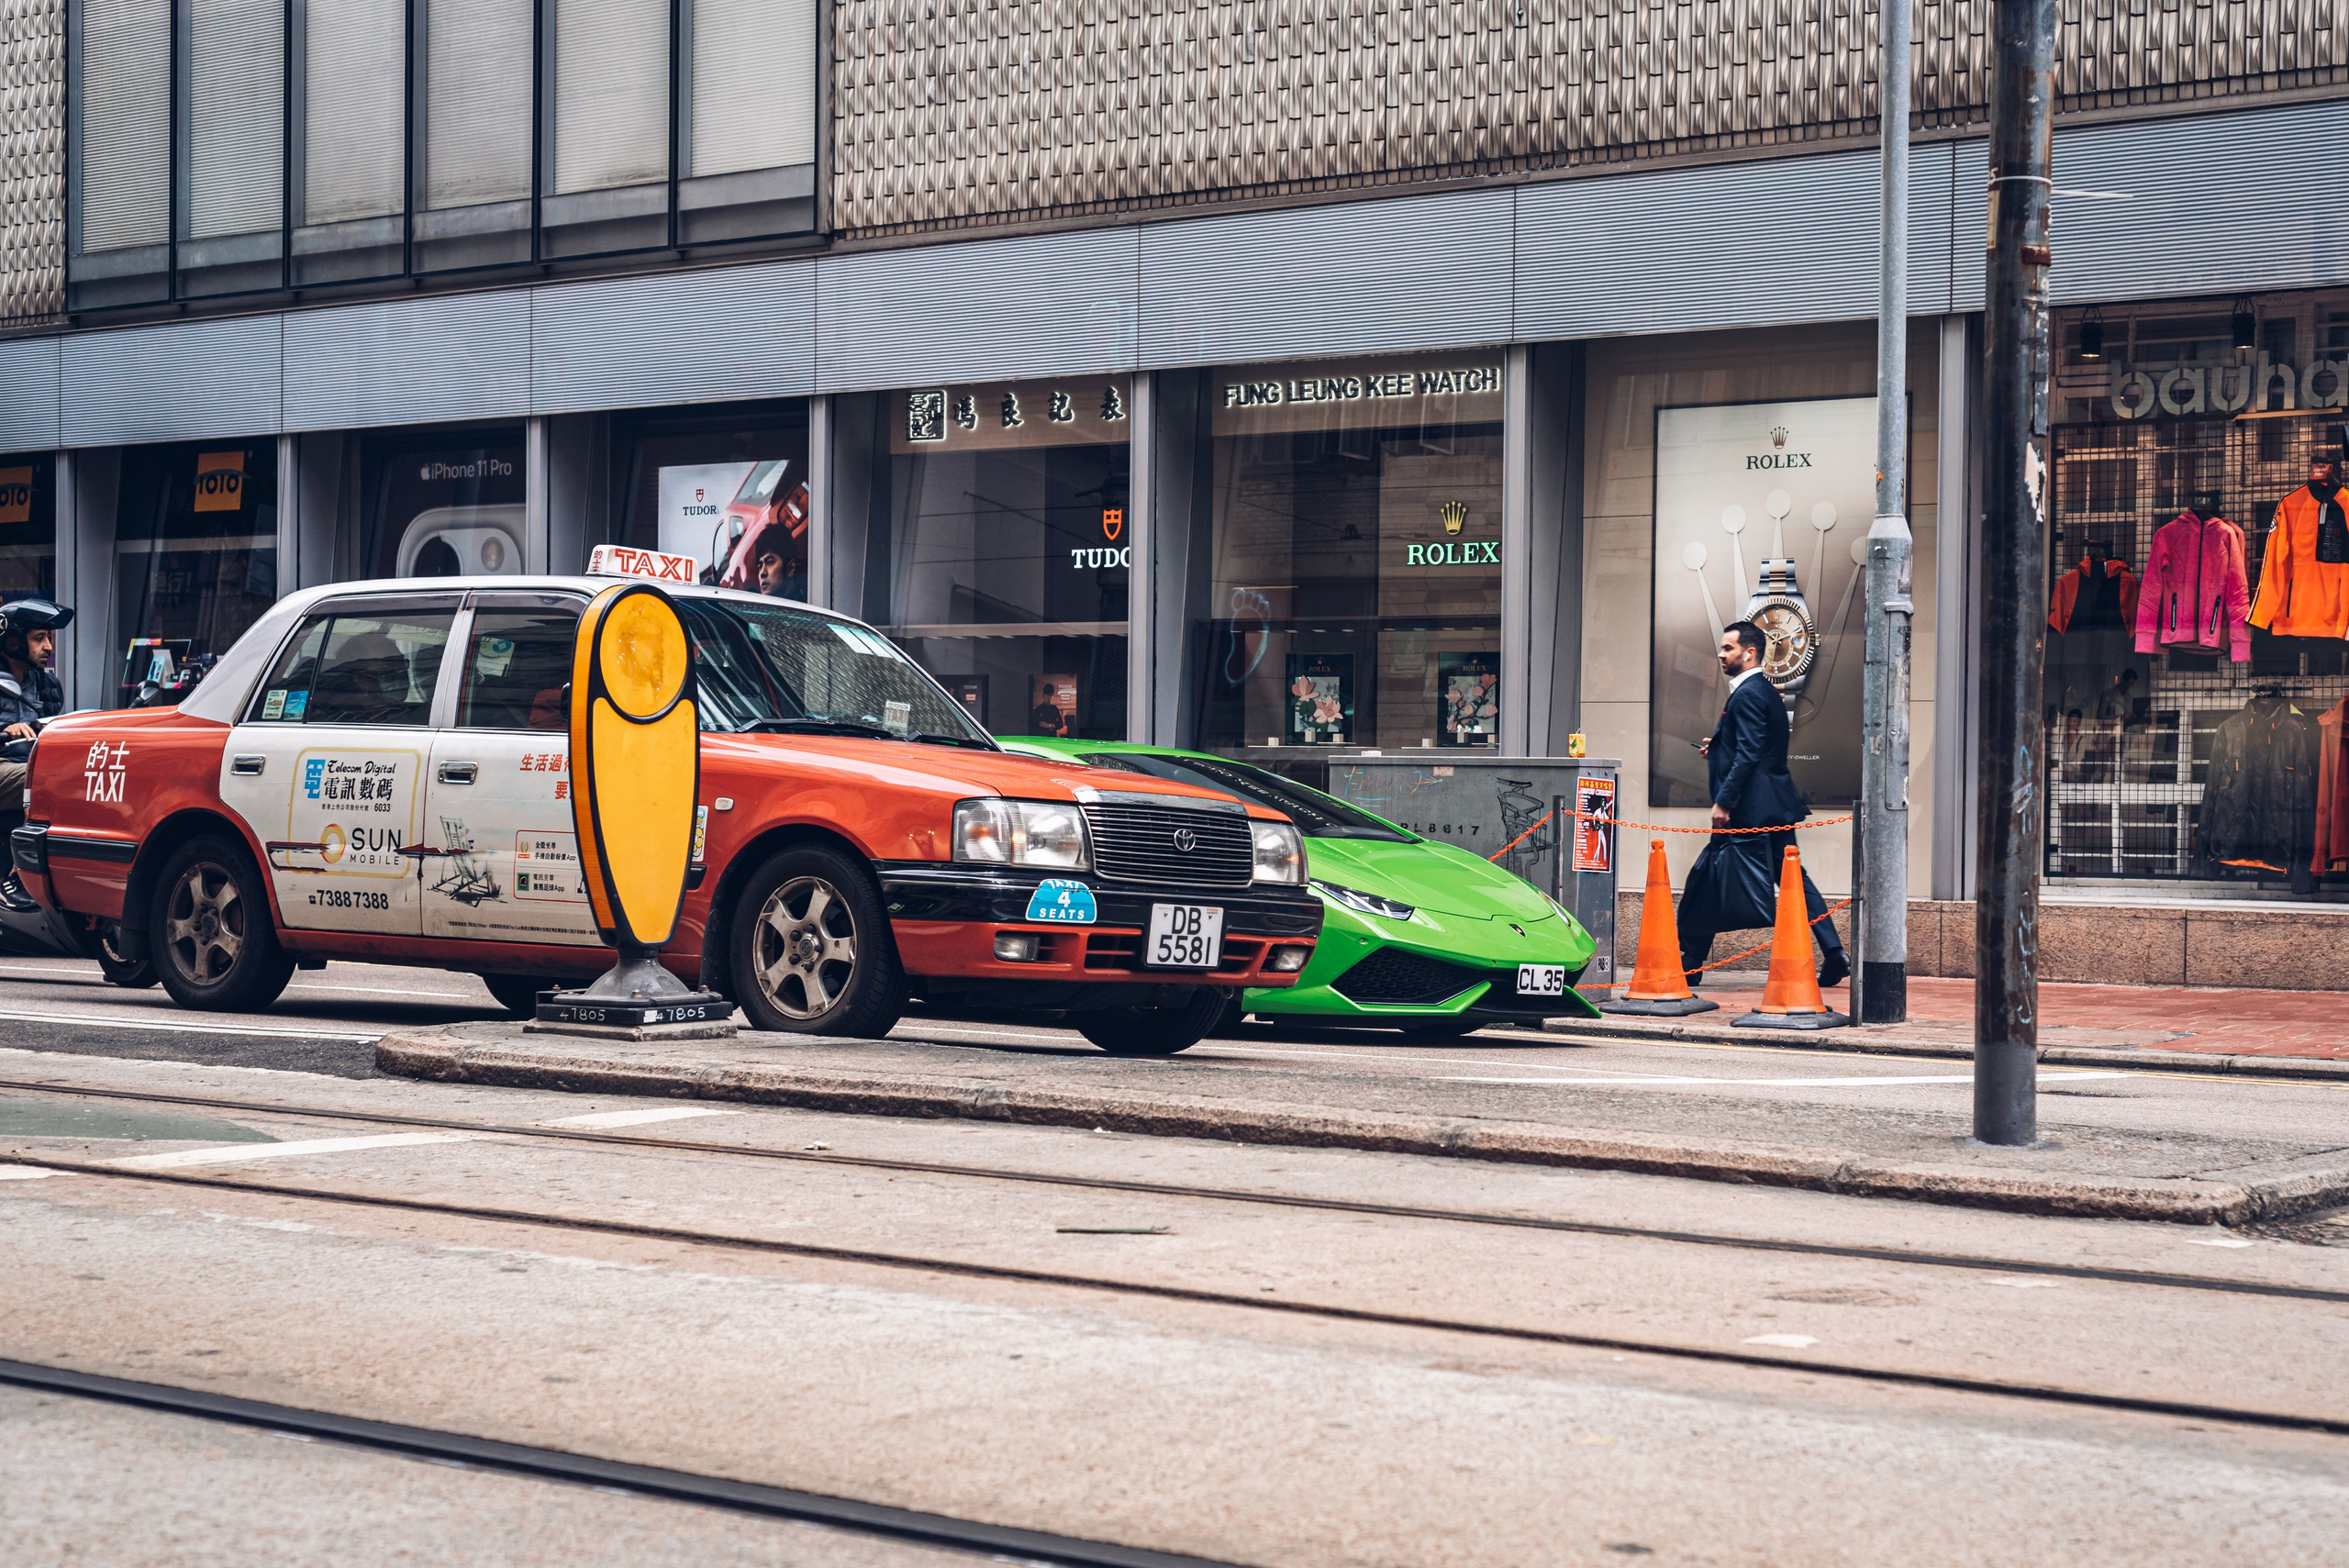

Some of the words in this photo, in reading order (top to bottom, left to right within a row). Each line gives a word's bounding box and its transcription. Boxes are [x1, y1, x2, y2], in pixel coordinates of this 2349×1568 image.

[1223, 382, 1282, 407] FUNG
[1286, 376, 1361, 404] LEUNG
[1365, 373, 1414, 398] KEE
[1418, 367, 1500, 395] WATCH
[2111, 350, 2349, 419] bauha
[431, 462, 475, 480] iPhone
[476, 460, 487, 477] 11
[490, 459, 512, 476] Pro
[1746, 453, 1812, 470] ROLEX
[197, 473, 240, 495] 1010
[683, 505, 718, 516] TUDOR
[592, 550, 604, 569] 的士
[1407, 541, 1500, 566] ROLEX
[615, 548, 694, 583] TAXI
[85, 740, 130, 770] 的士
[327, 760, 362, 774] Telecom
[363, 761, 397, 777] Digital
[84, 772, 127, 803] TAXI
[324, 776, 395, 802] 電訊數碼
[554, 781, 572, 800] 要
[373, 803, 392, 813] 6033
[351, 827, 402, 852] SUN
[350, 854, 400, 865] MOBILE
[1057, 888, 1072, 908] 4
[1039, 907, 1085, 920] SEATS
[1171, 906, 1202, 936] DB
[1157, 934, 1211, 965] 5581
[1519, 968, 1541, 992] CL
[1543, 969, 1564, 993] 35
